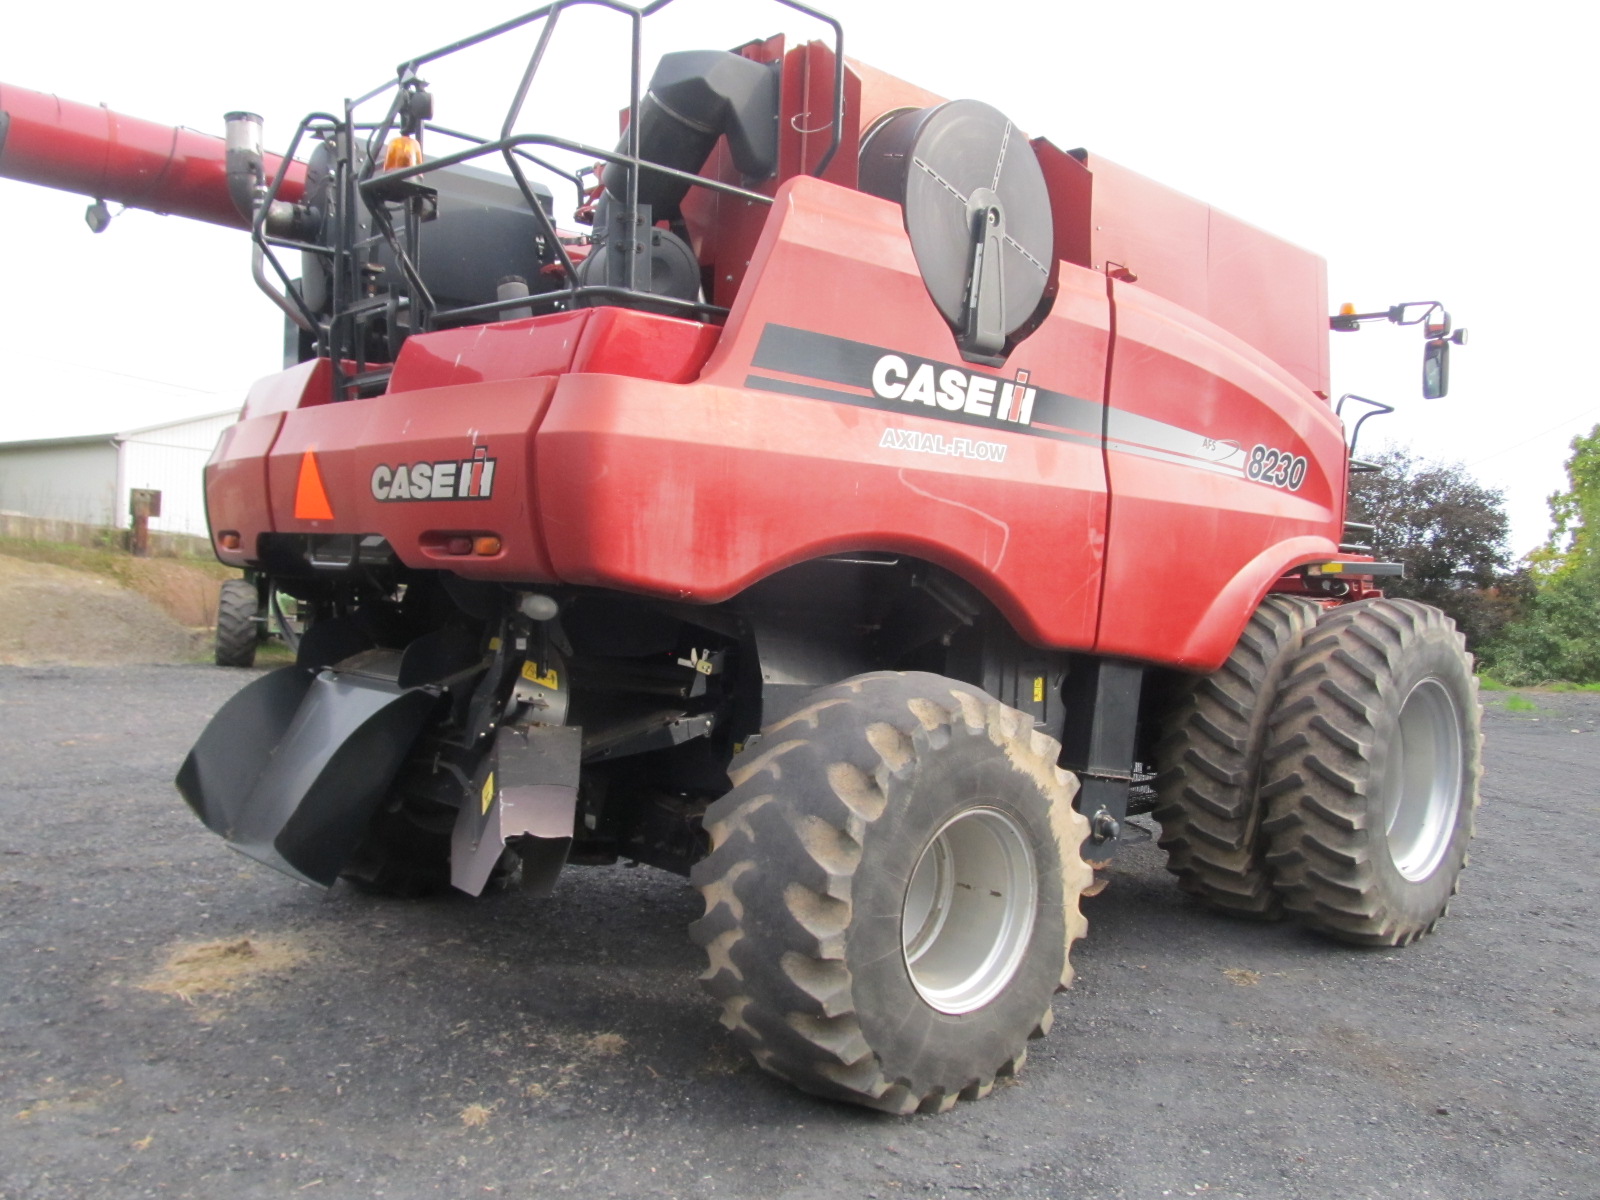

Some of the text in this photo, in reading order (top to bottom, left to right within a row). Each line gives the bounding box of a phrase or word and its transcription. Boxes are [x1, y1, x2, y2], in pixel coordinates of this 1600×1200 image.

[872, 354, 997, 417] CASE
[879, 427, 1007, 462] AXIAL-FLOW
[1202, 438, 1217, 452] AFS
[371, 462, 457, 500] CASE
[1247, 444, 1307, 491] 8230
